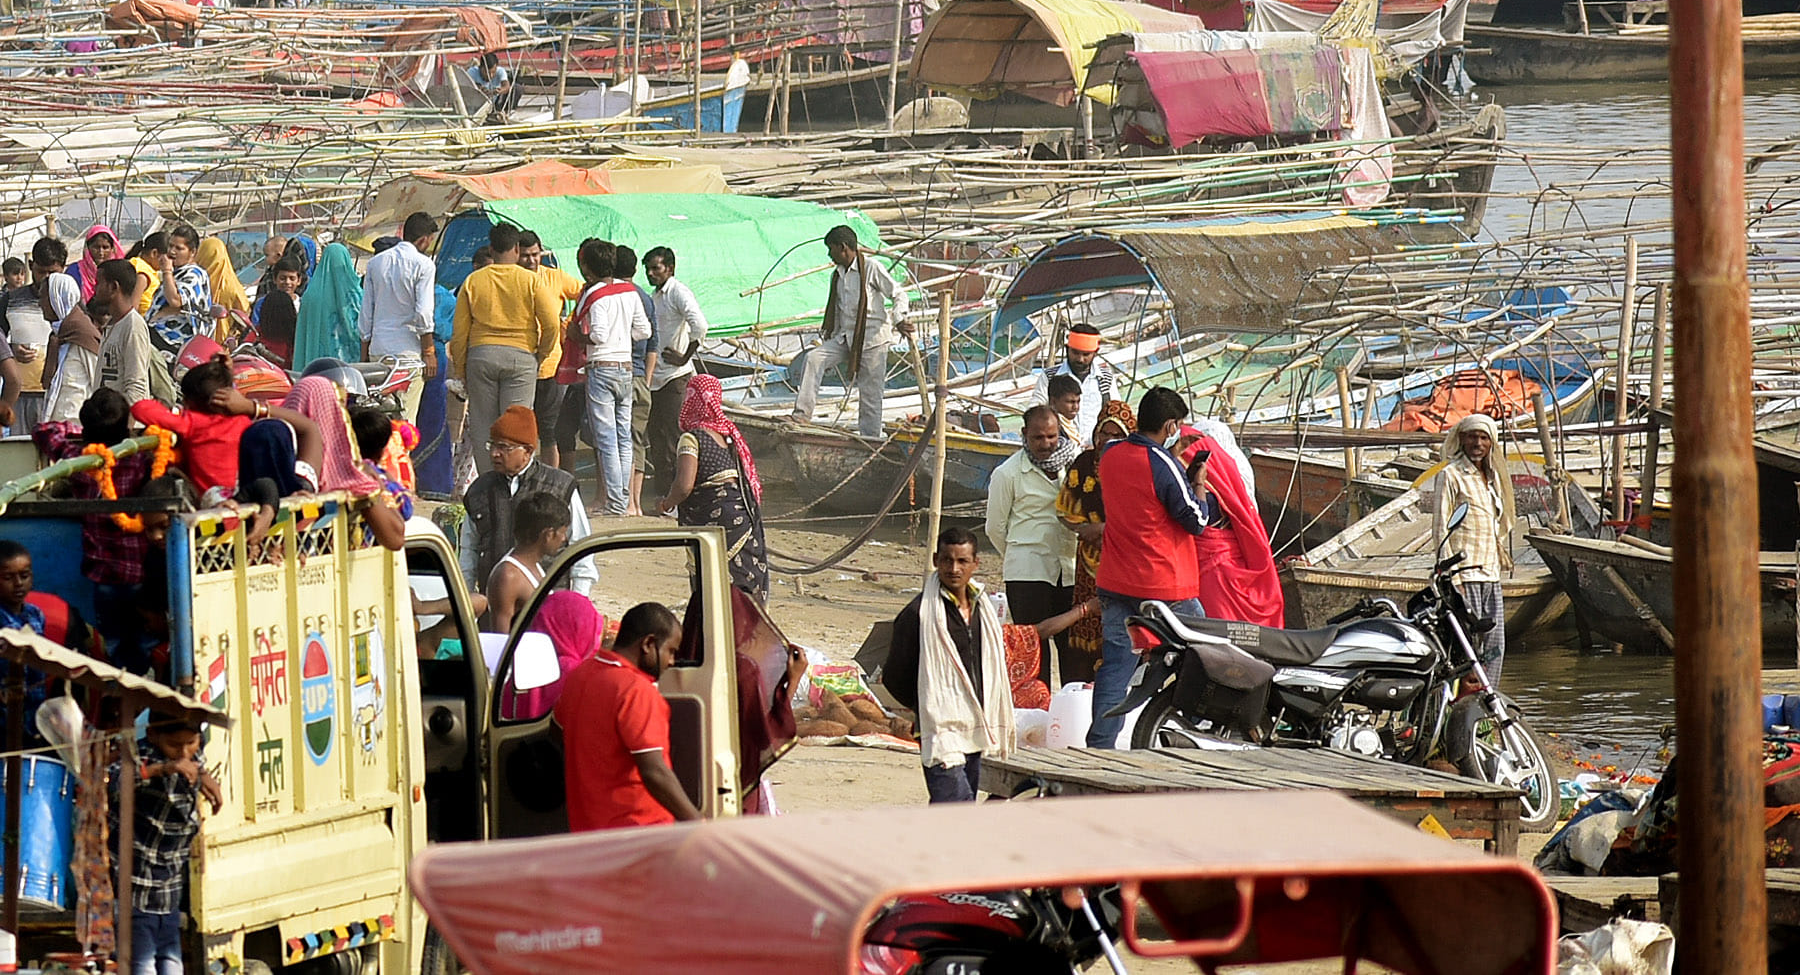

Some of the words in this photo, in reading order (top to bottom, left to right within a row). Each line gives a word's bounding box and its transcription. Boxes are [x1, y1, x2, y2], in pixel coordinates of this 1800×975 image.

[250, 631, 288, 717] सुमित
[304, 684, 328, 714] UP
[257, 721, 285, 795] मेल
